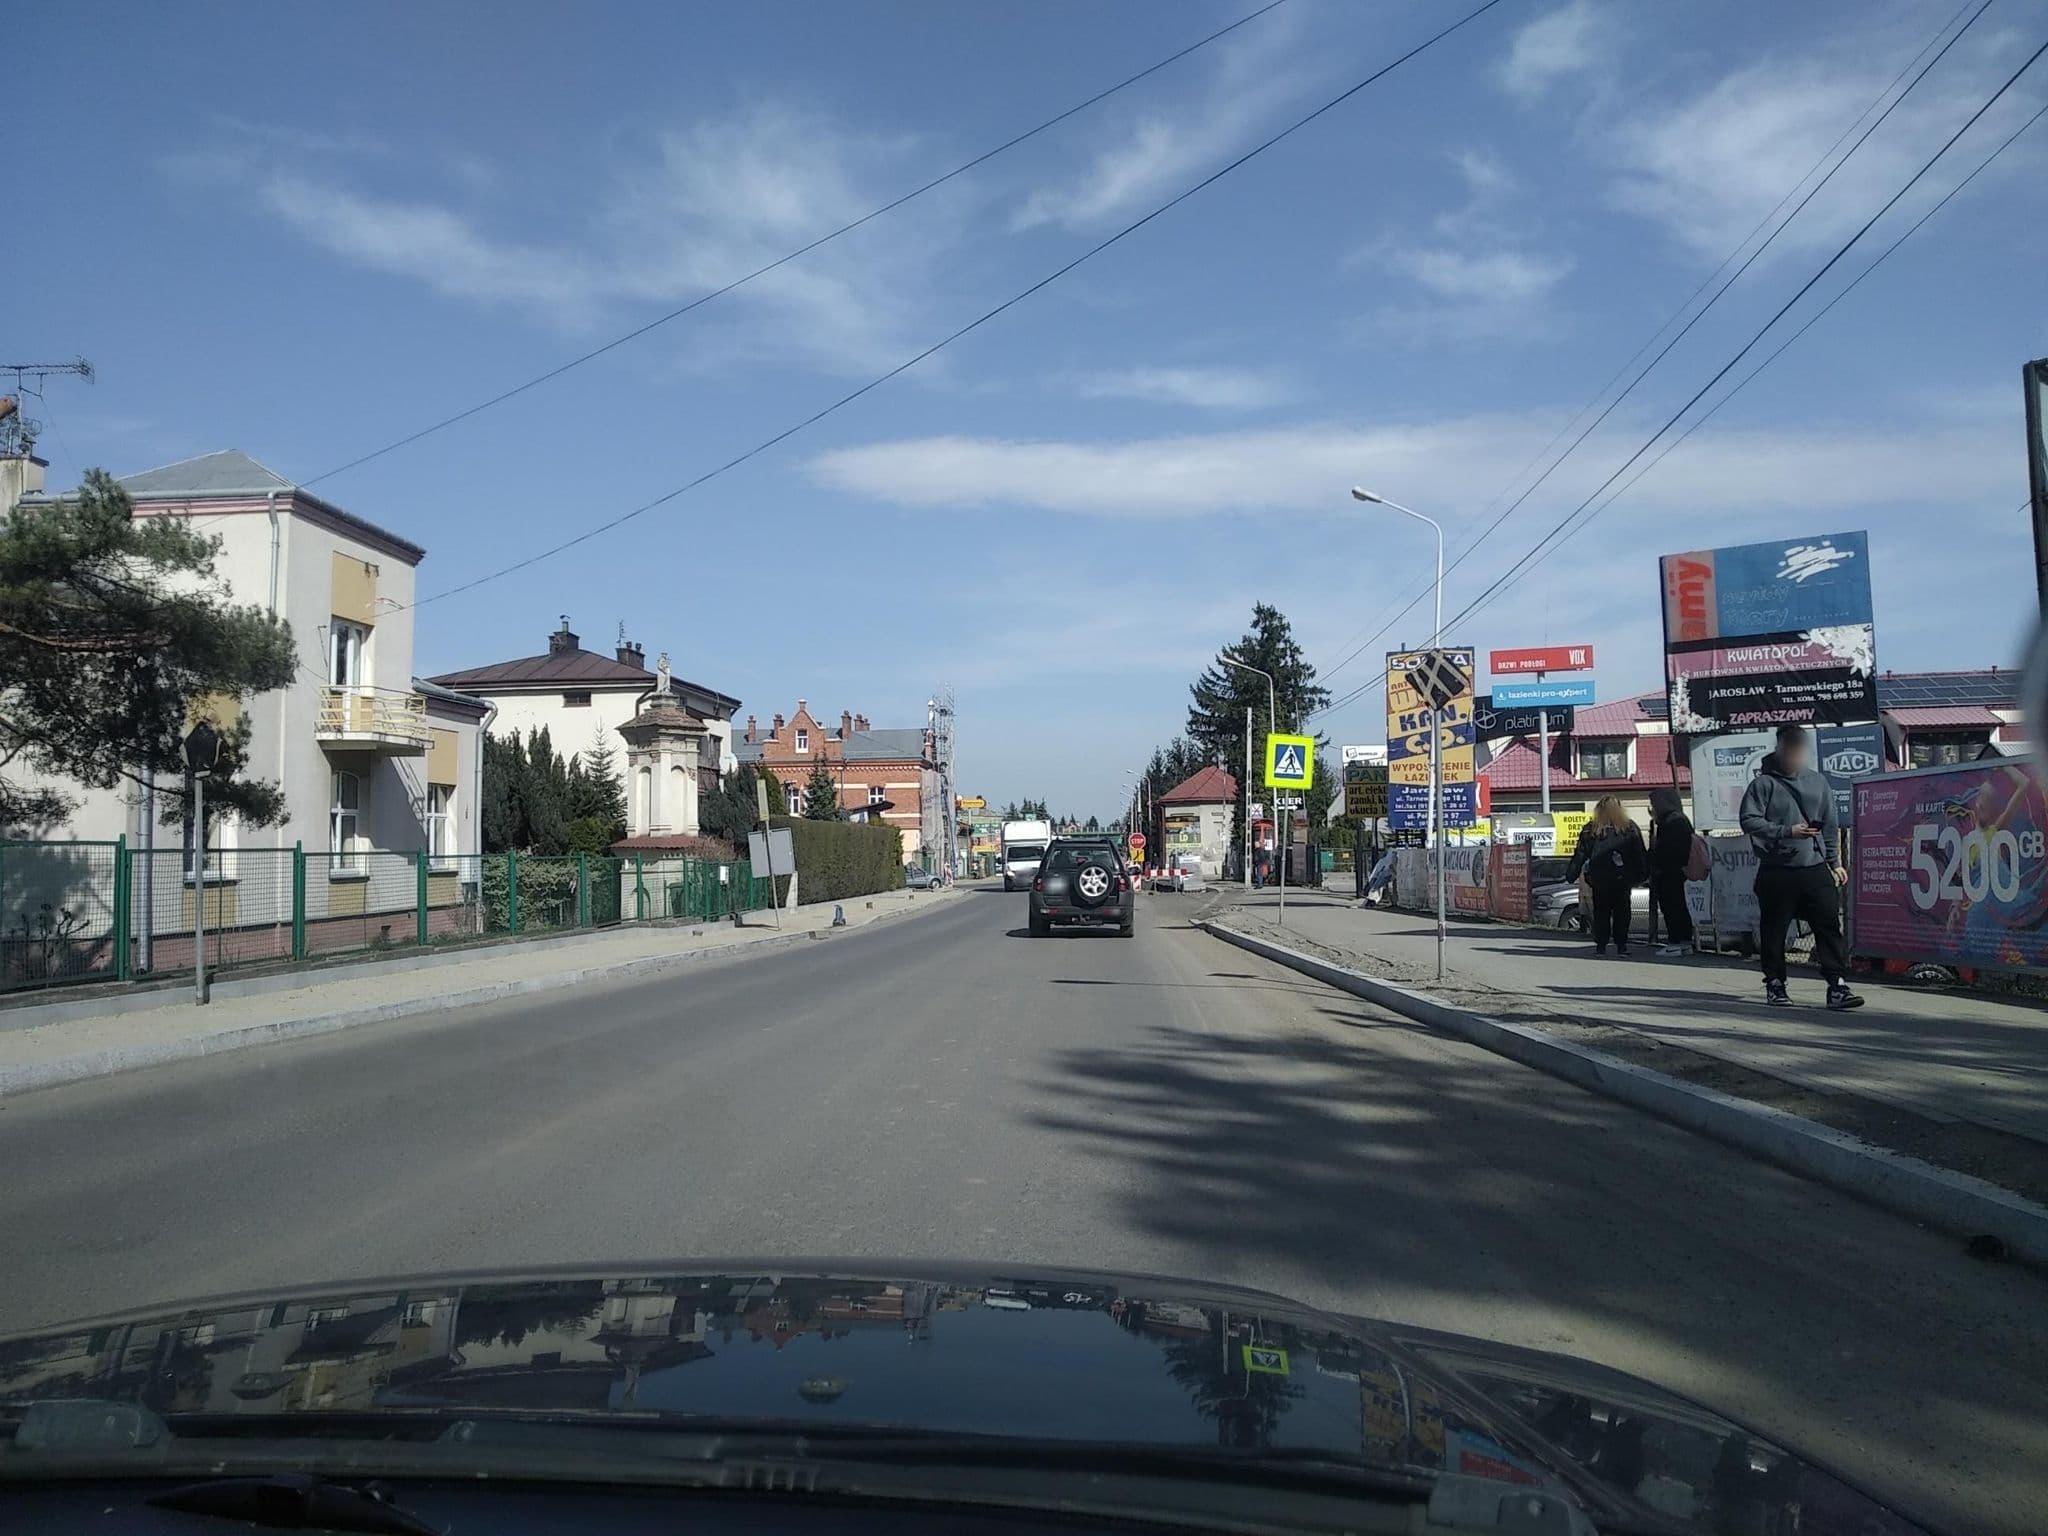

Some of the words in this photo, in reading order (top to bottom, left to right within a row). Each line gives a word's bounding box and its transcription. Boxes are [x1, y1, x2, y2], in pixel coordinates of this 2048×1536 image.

[1568, 648, 1586, 665] VOX
[1727, 645, 1809, 663] KWIATOPOL
[1708, 686, 1766, 700] JAROSŁAW
[1774, 681, 1845, 695] Tarnowskiego
[1729, 708, 1816, 725] ZAPRASZAMY
[1391, 761, 1471, 772] WYPOSENIE
[1822, 753, 1880, 772] MACH
[1404, 772, 1459, 782] ŁAZIEK
[1401, 786, 1465, 795] Jaroaw
[1130, 837, 1145, 845] STOP
[1910, 823, 2020, 910] 5200
[2019, 830, 2046, 859] GB
